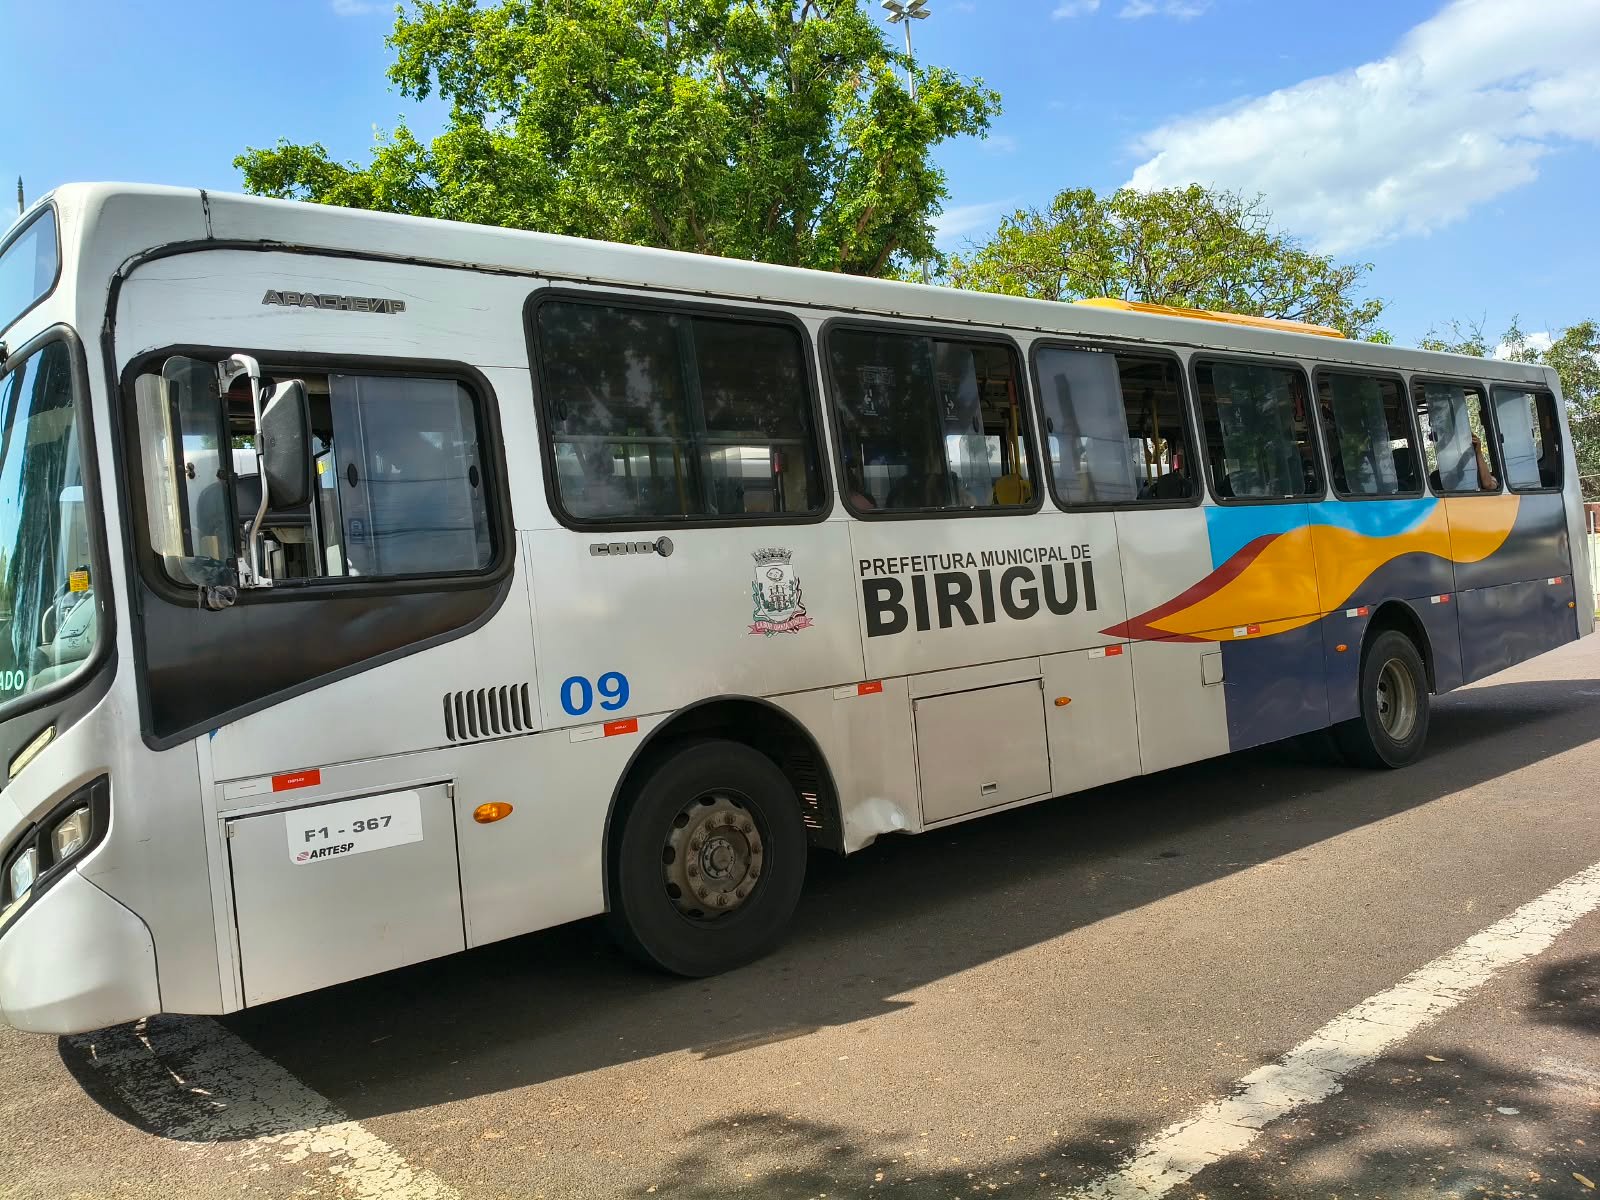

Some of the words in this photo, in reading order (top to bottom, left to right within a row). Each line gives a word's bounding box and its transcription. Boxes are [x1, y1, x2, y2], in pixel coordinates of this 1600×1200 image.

[860, 552, 977, 577] PREFEITURA
[981, 546, 1067, 567] MUNICIPAL
[1071, 544, 1091, 560] DE
[862, 560, 1097, 638] BIRIGUI
[560, 671, 630, 716] 09
[304, 827, 329, 842] F1
[352, 815, 392, 833] 367
[310, 843, 354, 860] ARTESP
